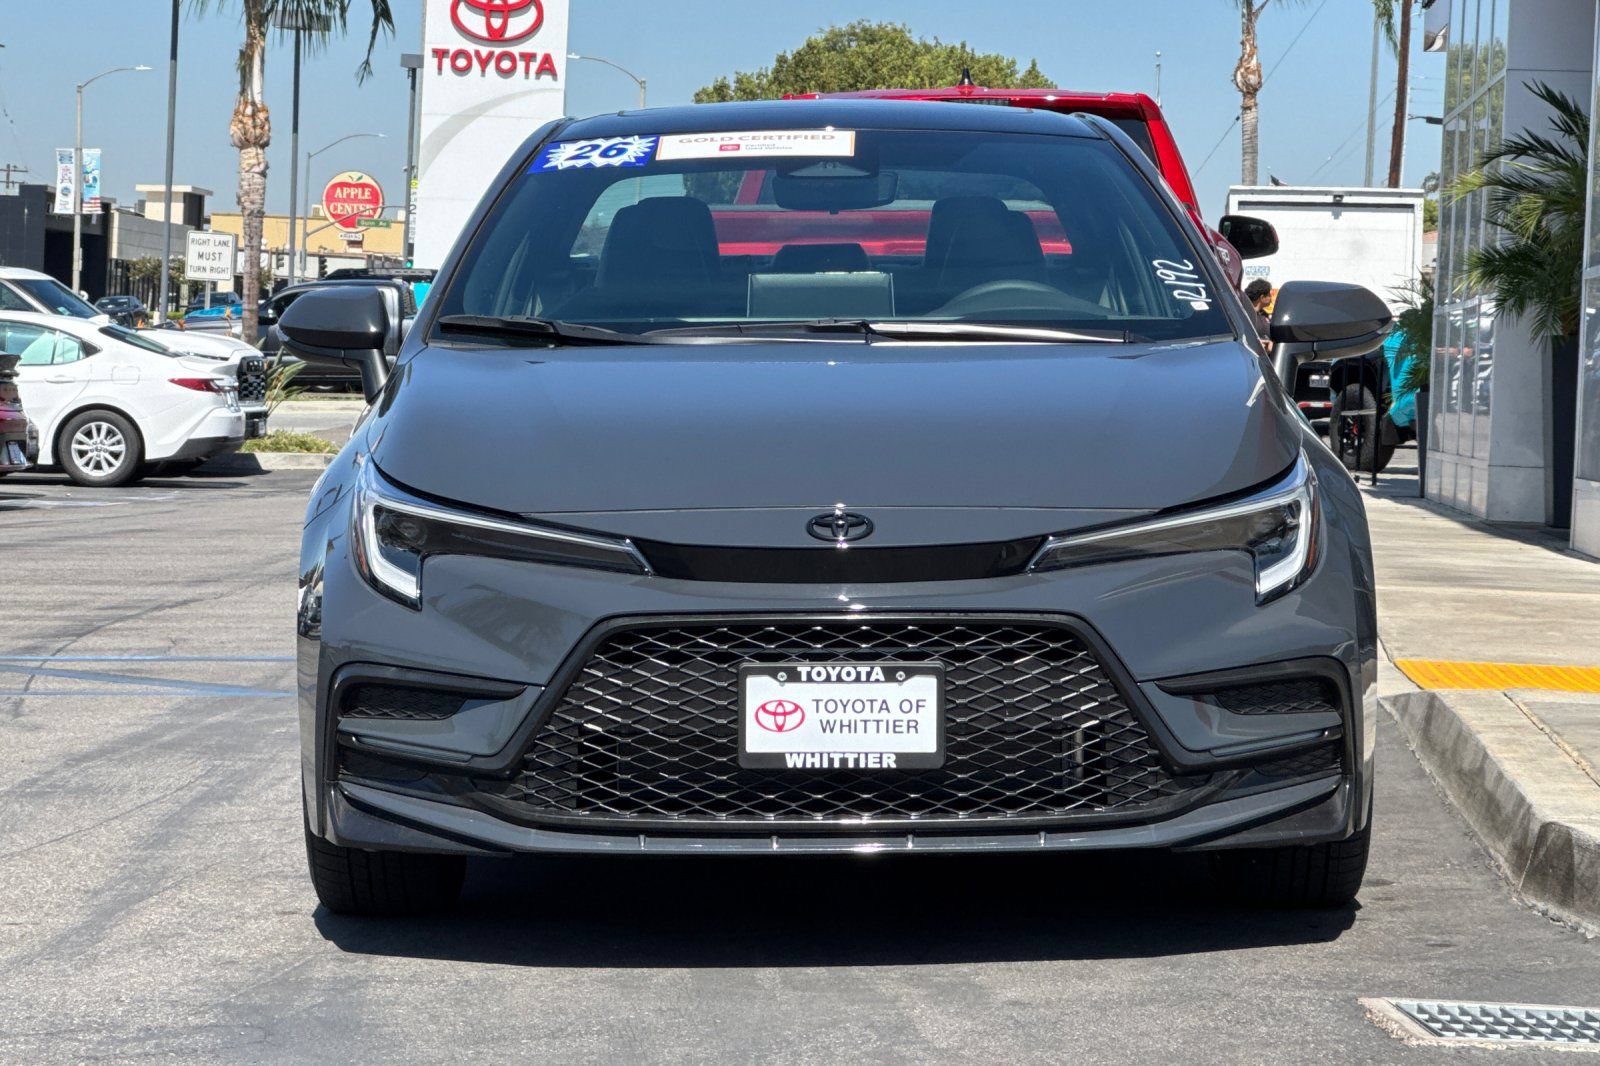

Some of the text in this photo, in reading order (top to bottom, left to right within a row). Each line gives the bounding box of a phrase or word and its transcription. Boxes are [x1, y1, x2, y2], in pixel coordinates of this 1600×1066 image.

[432, 48, 558, 81] TOYOTA
[679, 136, 733, 144] GOLD
[564, 142, 633, 162] 26
[334, 187, 372, 199] APPLE
[330, 202, 374, 215] CENTER
[191, 237, 231, 248] RIGHT LANE
[198, 251, 222, 262] MUST
[190, 265, 230, 275] TURN RIGHT
[797, 666, 885, 682] TOYOTA
[812, 699, 927, 713] TOYOTA OF
[819, 719, 919, 734] WHITTIER
[785, 753, 897, 768] WHITTIER
